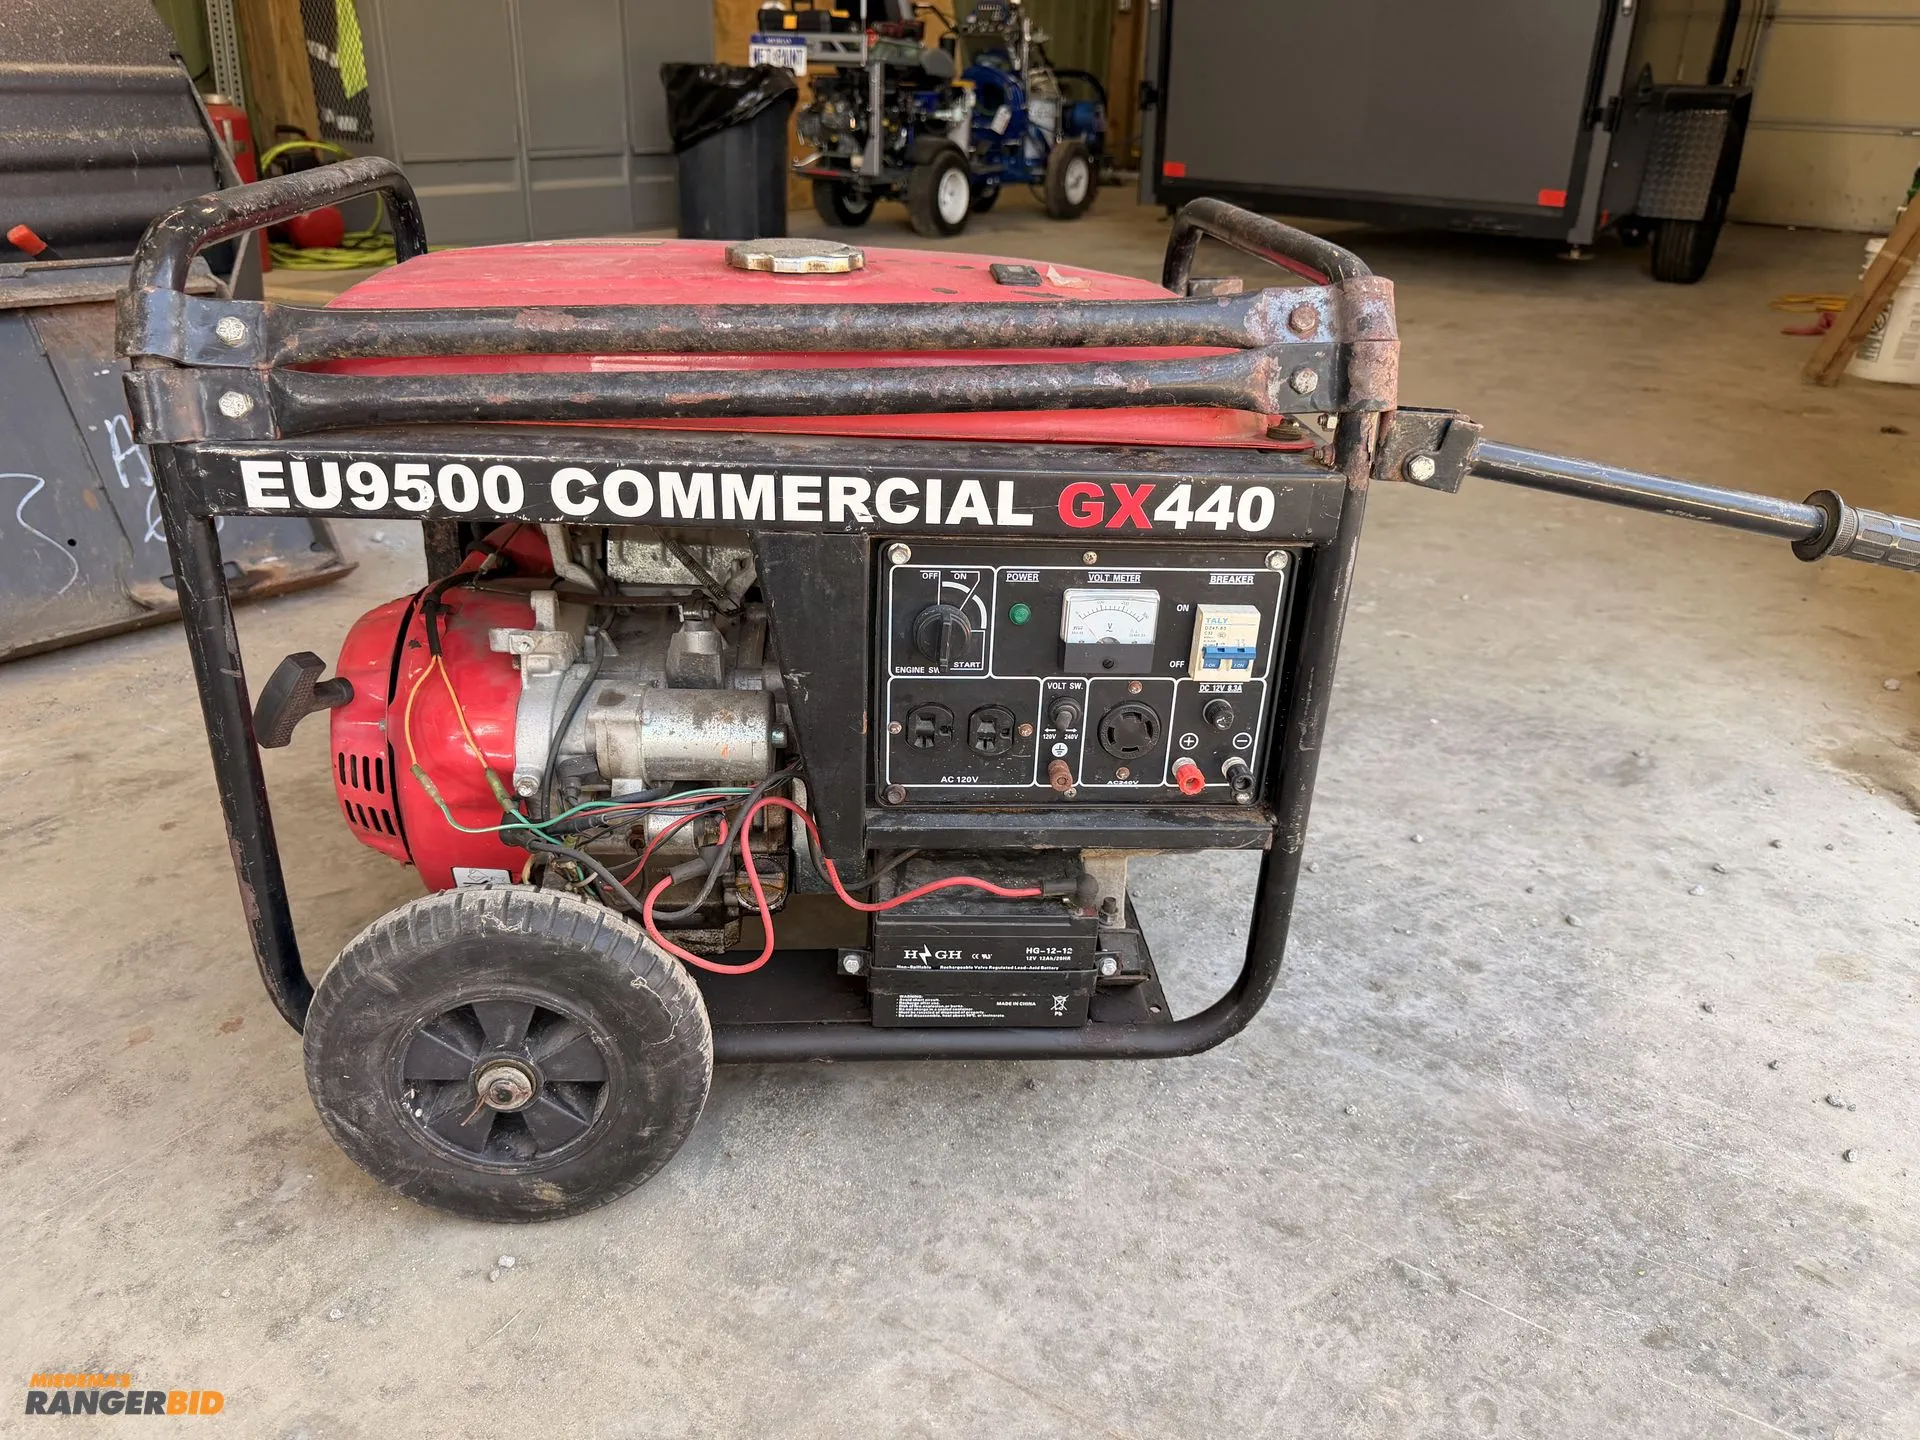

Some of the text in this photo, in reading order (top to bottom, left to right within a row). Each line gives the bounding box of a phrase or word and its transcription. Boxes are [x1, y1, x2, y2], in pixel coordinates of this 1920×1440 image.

[239, 460, 1276, 532] EU9500 COMMERCIAL GX440
[1006, 573, 1039, 581] POWER
[1088, 573, 1141, 582] VOLT METER
[1210, 575, 1254, 584] BREAKER
[1176, 604, 1190, 612] ON
[1047, 682, 1084, 690] VOLT SW.
